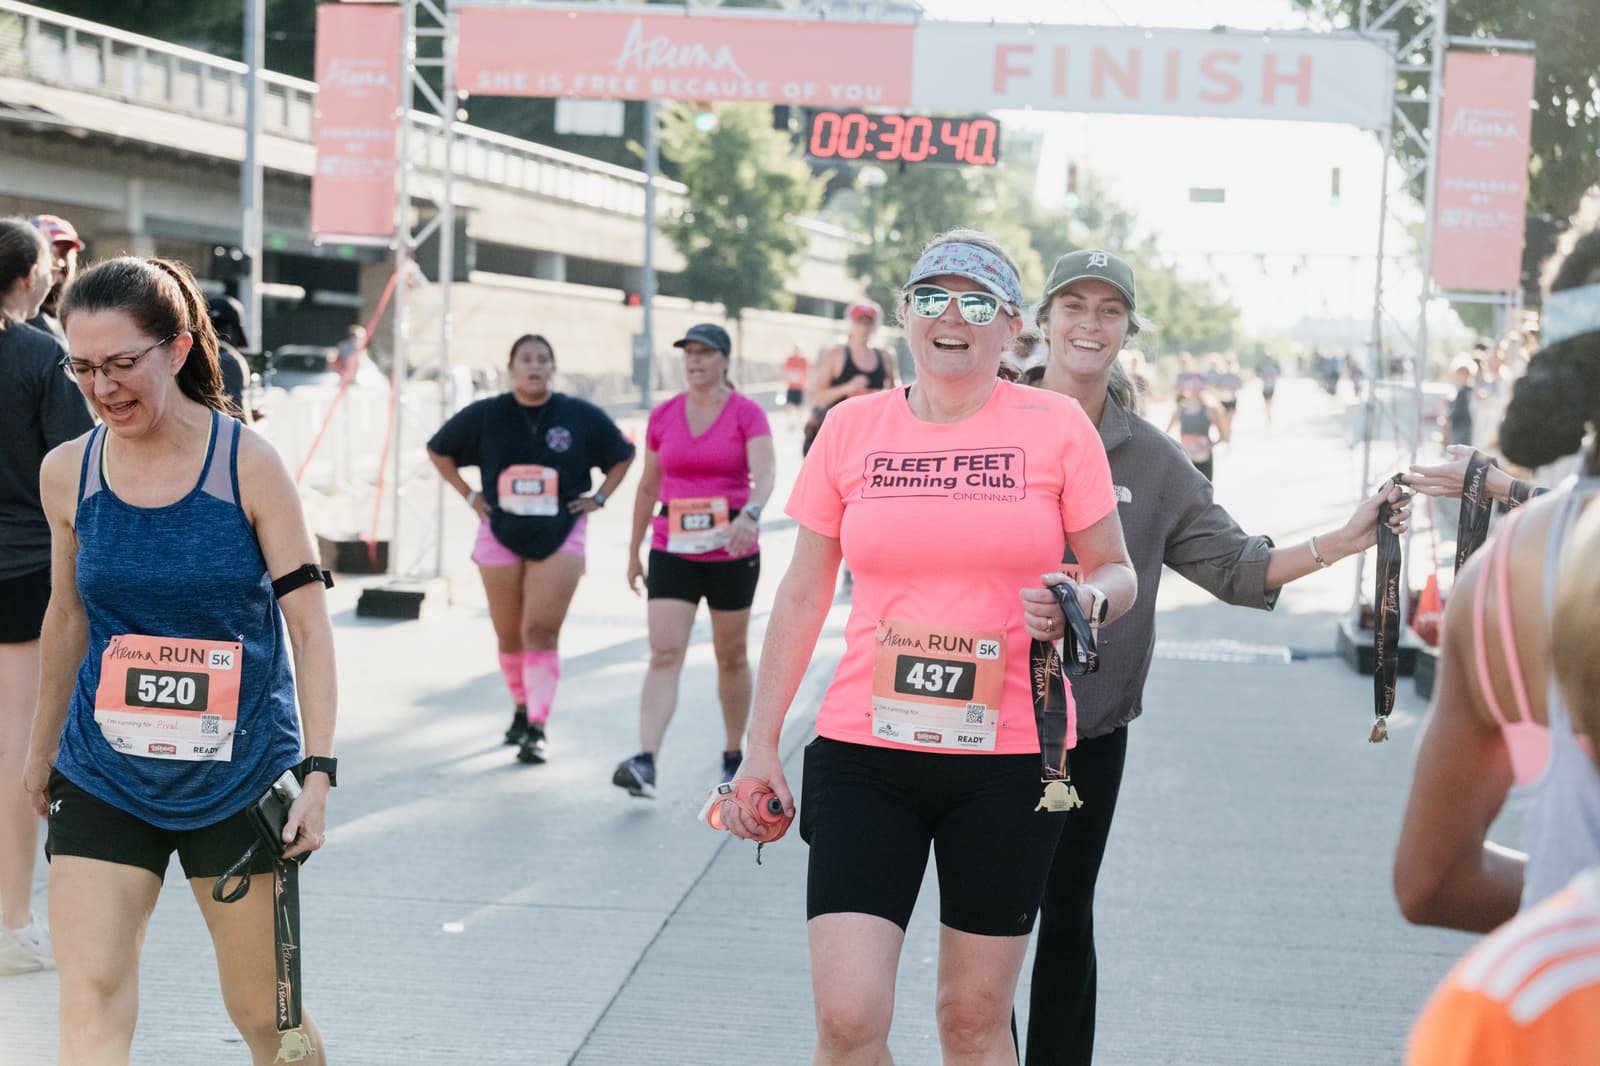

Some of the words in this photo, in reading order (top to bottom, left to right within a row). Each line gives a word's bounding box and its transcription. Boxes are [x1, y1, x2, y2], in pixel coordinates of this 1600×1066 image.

[993, 43, 1314, 107] FINISH
[477, 71, 528, 91] SHE
[538, 73, 563, 92] IS
[575, 74, 639, 95] FREE
[651, 77, 769, 98] BECAUSE
[783, 82, 818, 99] OF
[829, 84, 883, 102] YOU
[872, 457, 948, 473] FLEET
[953, 453, 1015, 472] FEET
[870, 474, 958, 490] Running
[965, 473, 1016, 489] Club
[952, 492, 1017, 503] CINCINNATI
[928, 634, 974, 654] RUN
[979, 643, 997, 656] 5K
[159, 646, 206, 664] RUN
[211, 654, 231, 666] 5K
[906, 662, 964, 694] 437
[137, 674, 196, 705] 520
[958, 735, 984, 744] READY
[193, 746, 219, 754] READY
